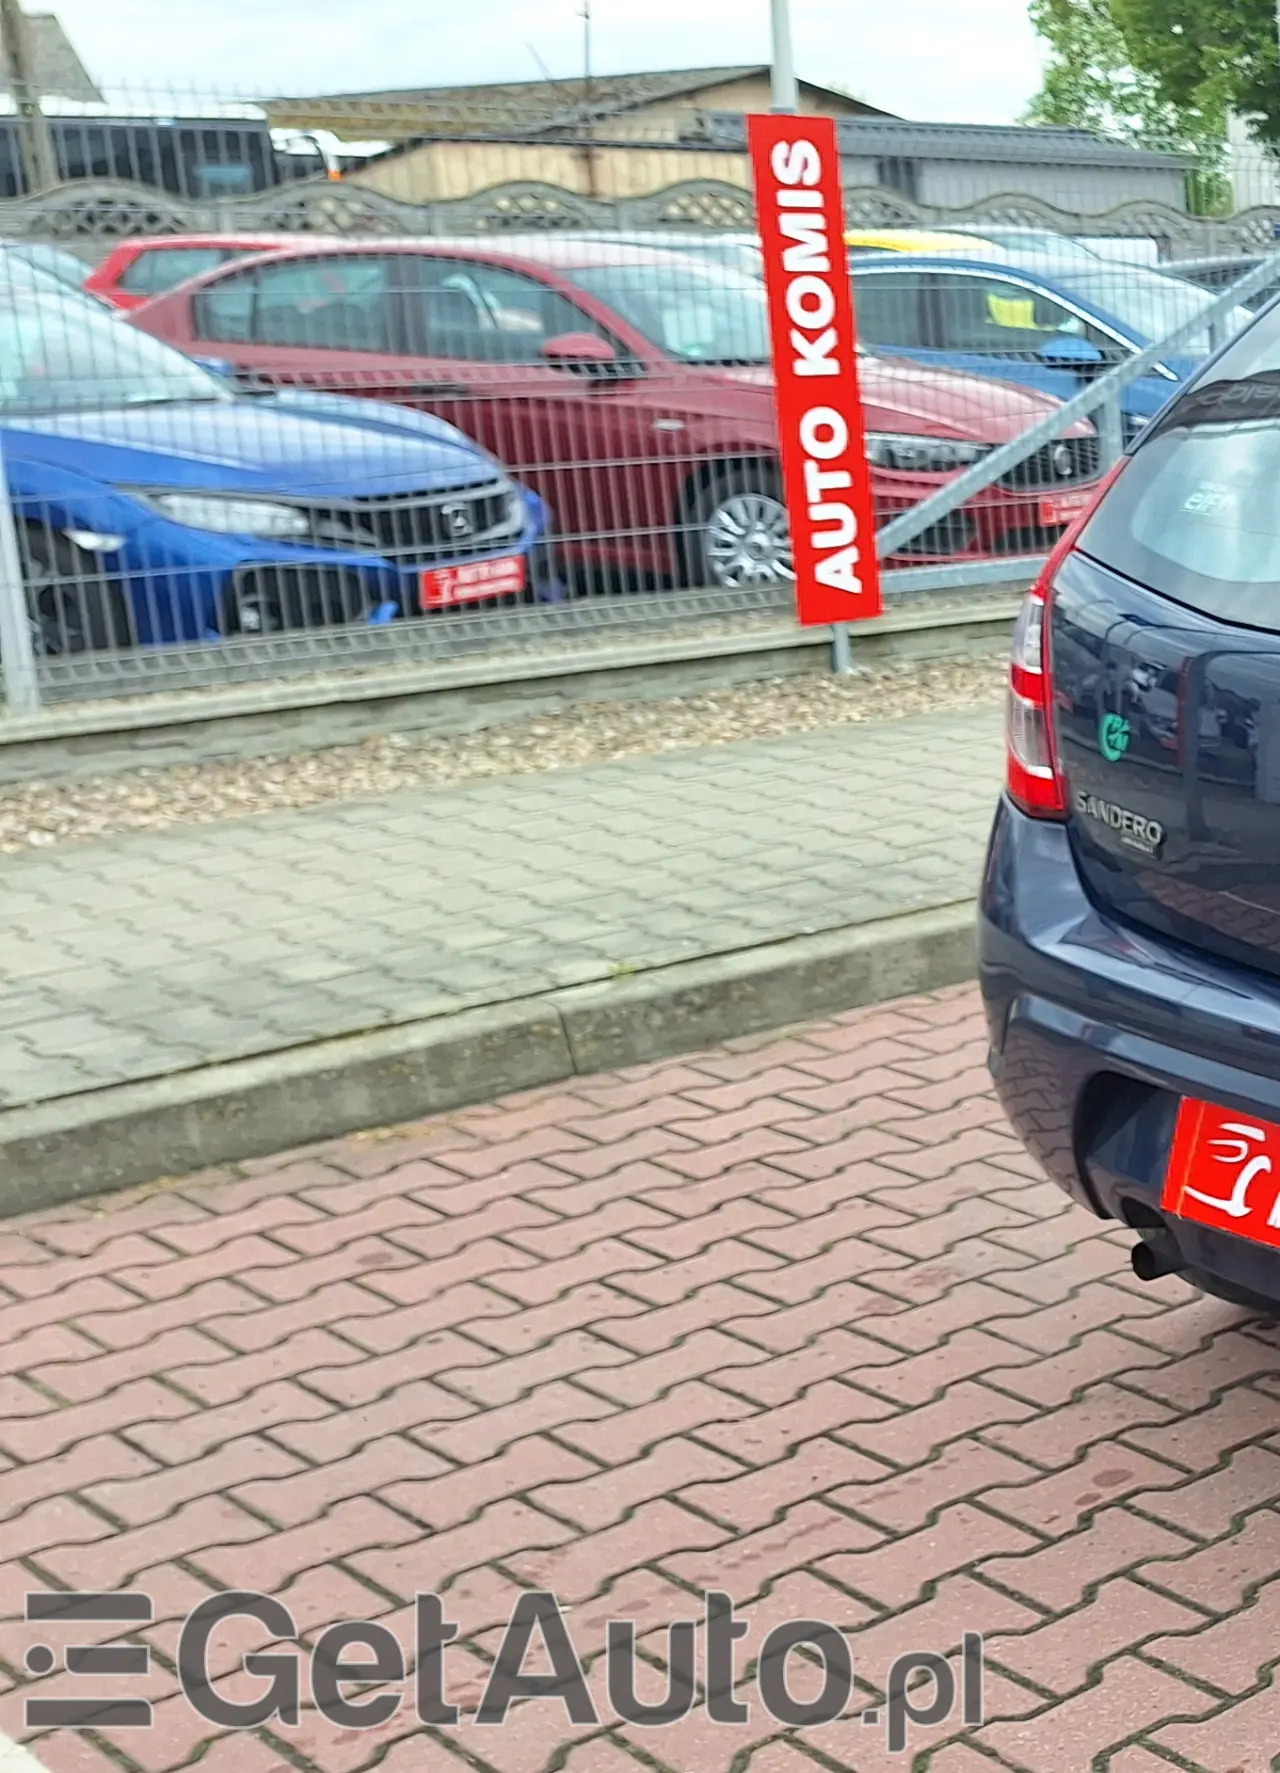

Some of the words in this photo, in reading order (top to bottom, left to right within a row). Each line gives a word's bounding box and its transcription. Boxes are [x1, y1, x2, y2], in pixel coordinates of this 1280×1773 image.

[770, 139, 842, 377] KOMIS
[799, 406, 863, 594] AUTO
[1076, 790, 1163, 845] SANDERO
